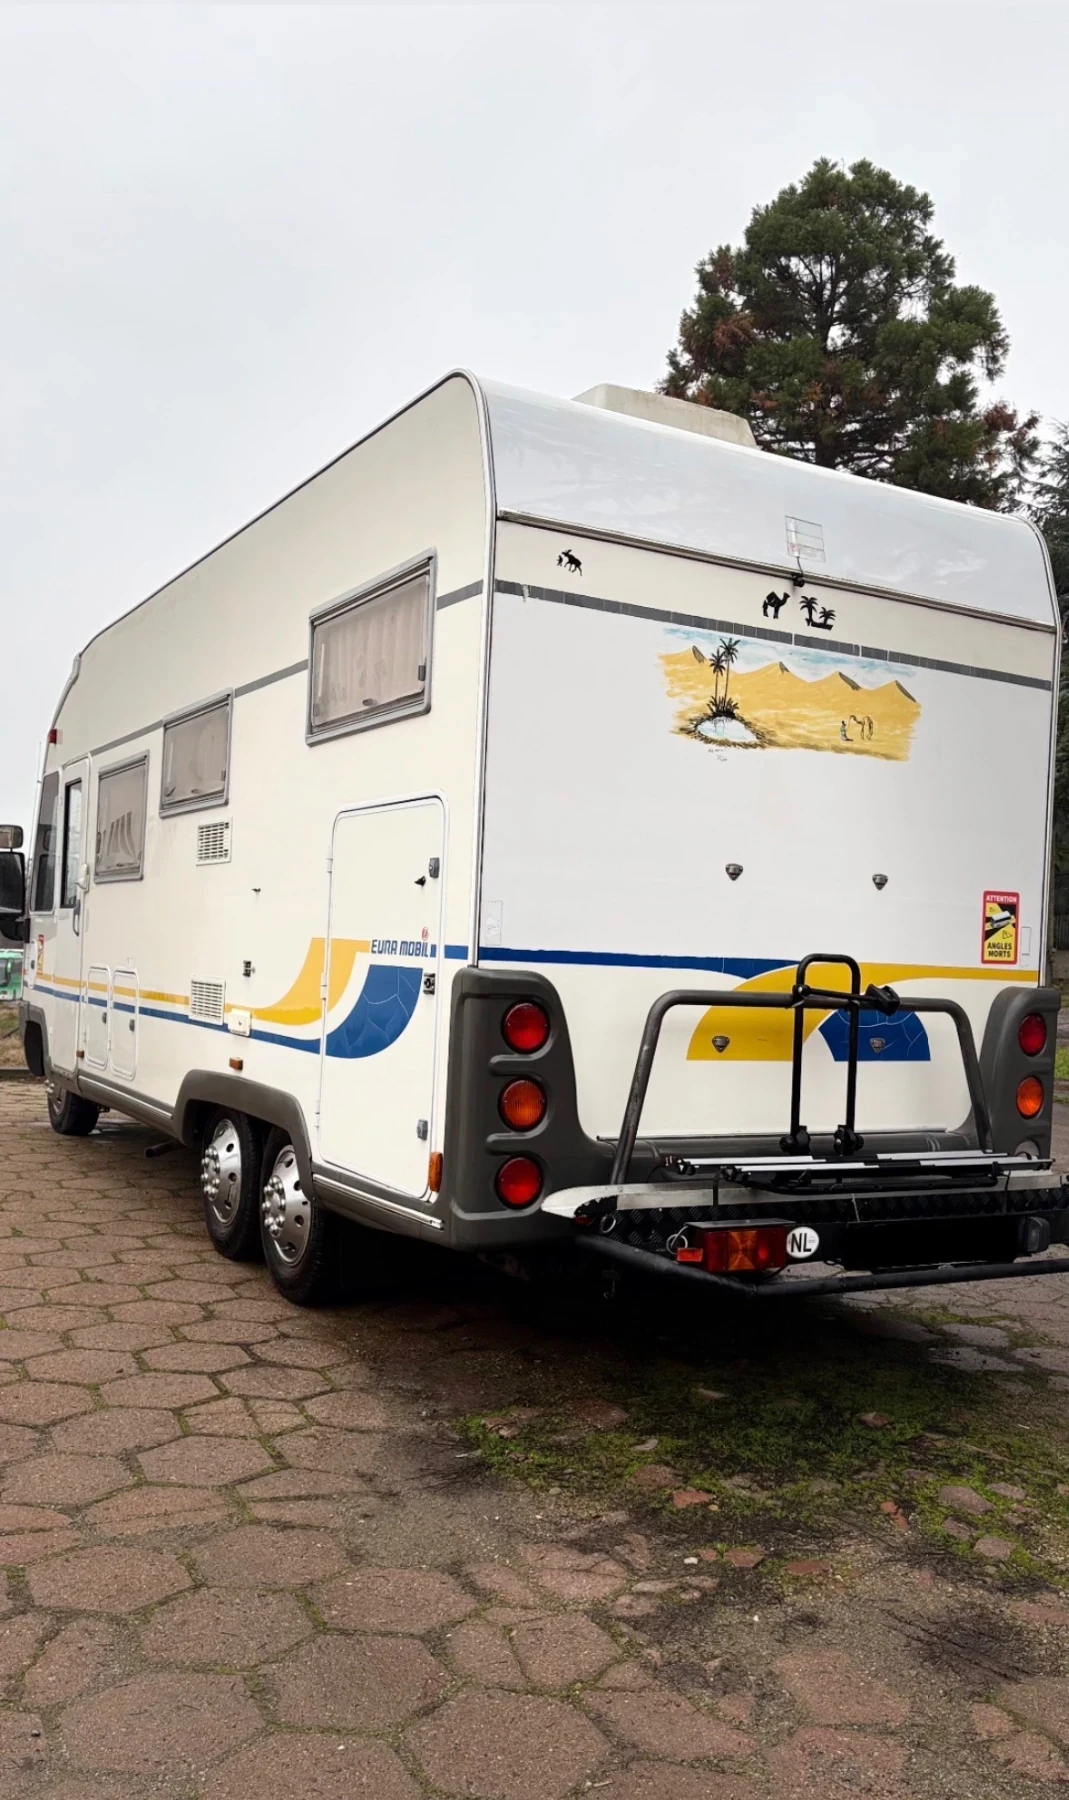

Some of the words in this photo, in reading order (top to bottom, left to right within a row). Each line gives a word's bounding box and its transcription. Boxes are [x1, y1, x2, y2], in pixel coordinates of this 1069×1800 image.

[985, 895, 1017, 903] ATTENTION
[371, 939, 398, 955] EURA
[400, 941, 428, 958] MOBIL
[987, 942, 1012, 950] ANGLES
[988, 950, 1011, 958] MORTS
[791, 1232, 812, 1253] NL
